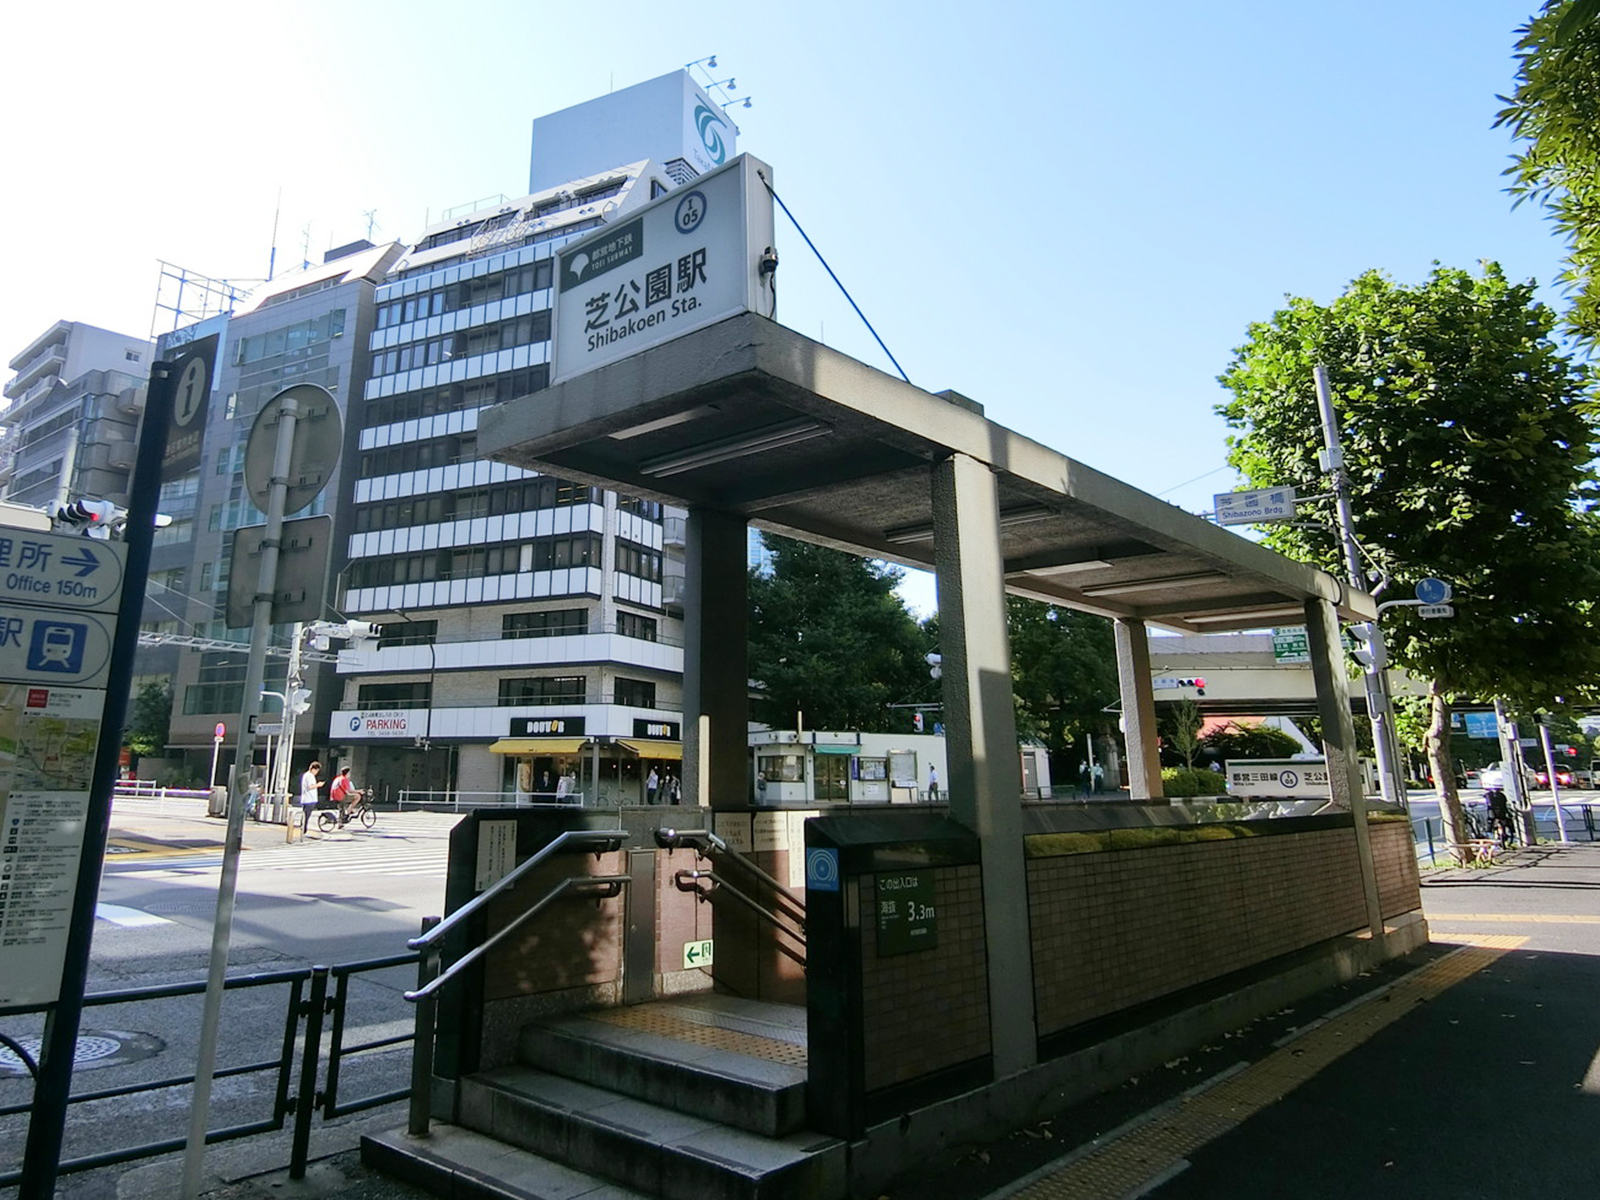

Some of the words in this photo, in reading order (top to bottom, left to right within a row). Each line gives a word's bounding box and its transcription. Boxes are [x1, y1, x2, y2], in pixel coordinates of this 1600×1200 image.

[682, 209, 698, 226] 05
[607, 245, 632, 264] SUBWAY
[584, 247, 707, 334] 芝公園駅
[587, 308, 665, 352] Shibakoen
[671, 297, 702, 318] Sta.
[7, 573, 51, 594] Office
[57, 580, 97, 599] 150m
[366, 719, 406, 730] PARKING
[526, 720, 565, 734] DOUTOR
[1233, 773, 1278, 782] 都営三田線
[880, 877, 918, 890] この出入口は
[907, 901, 935, 922] 3.3m
